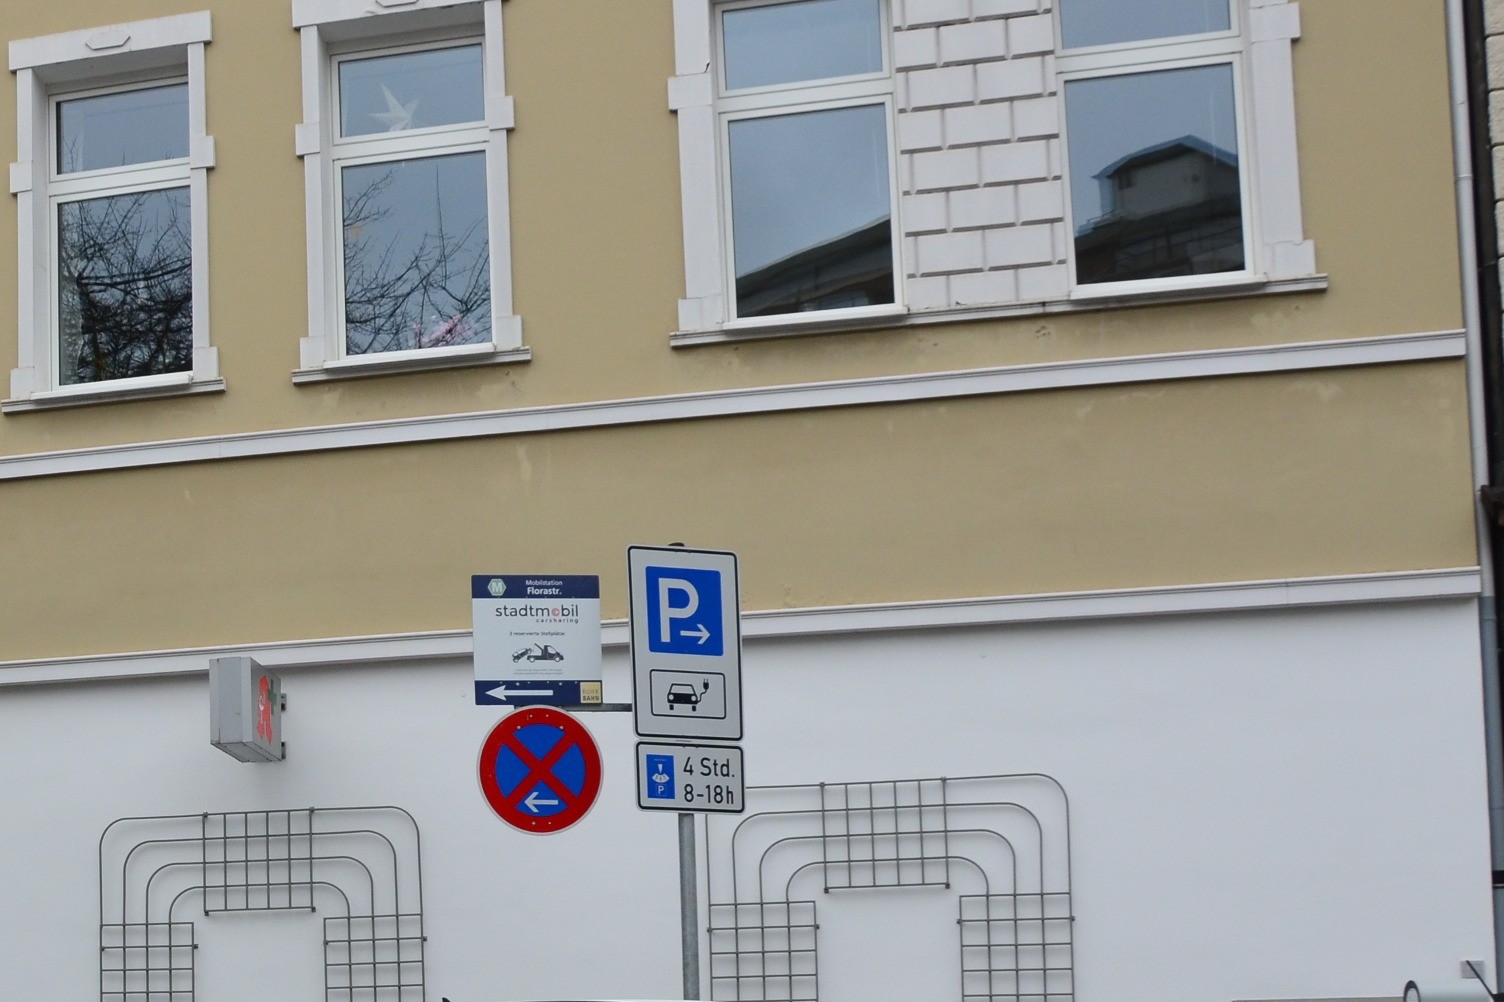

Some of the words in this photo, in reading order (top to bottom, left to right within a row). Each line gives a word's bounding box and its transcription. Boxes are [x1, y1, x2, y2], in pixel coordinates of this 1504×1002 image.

[526, 587, 563, 595] Florastr.
[495, 604, 579, 617] stadtmobil
[659, 577, 699, 643] P
[683, 756, 694, 776] 4
[700, 757, 735, 778] Std.
[684, 783, 734, 805] 8-18h
